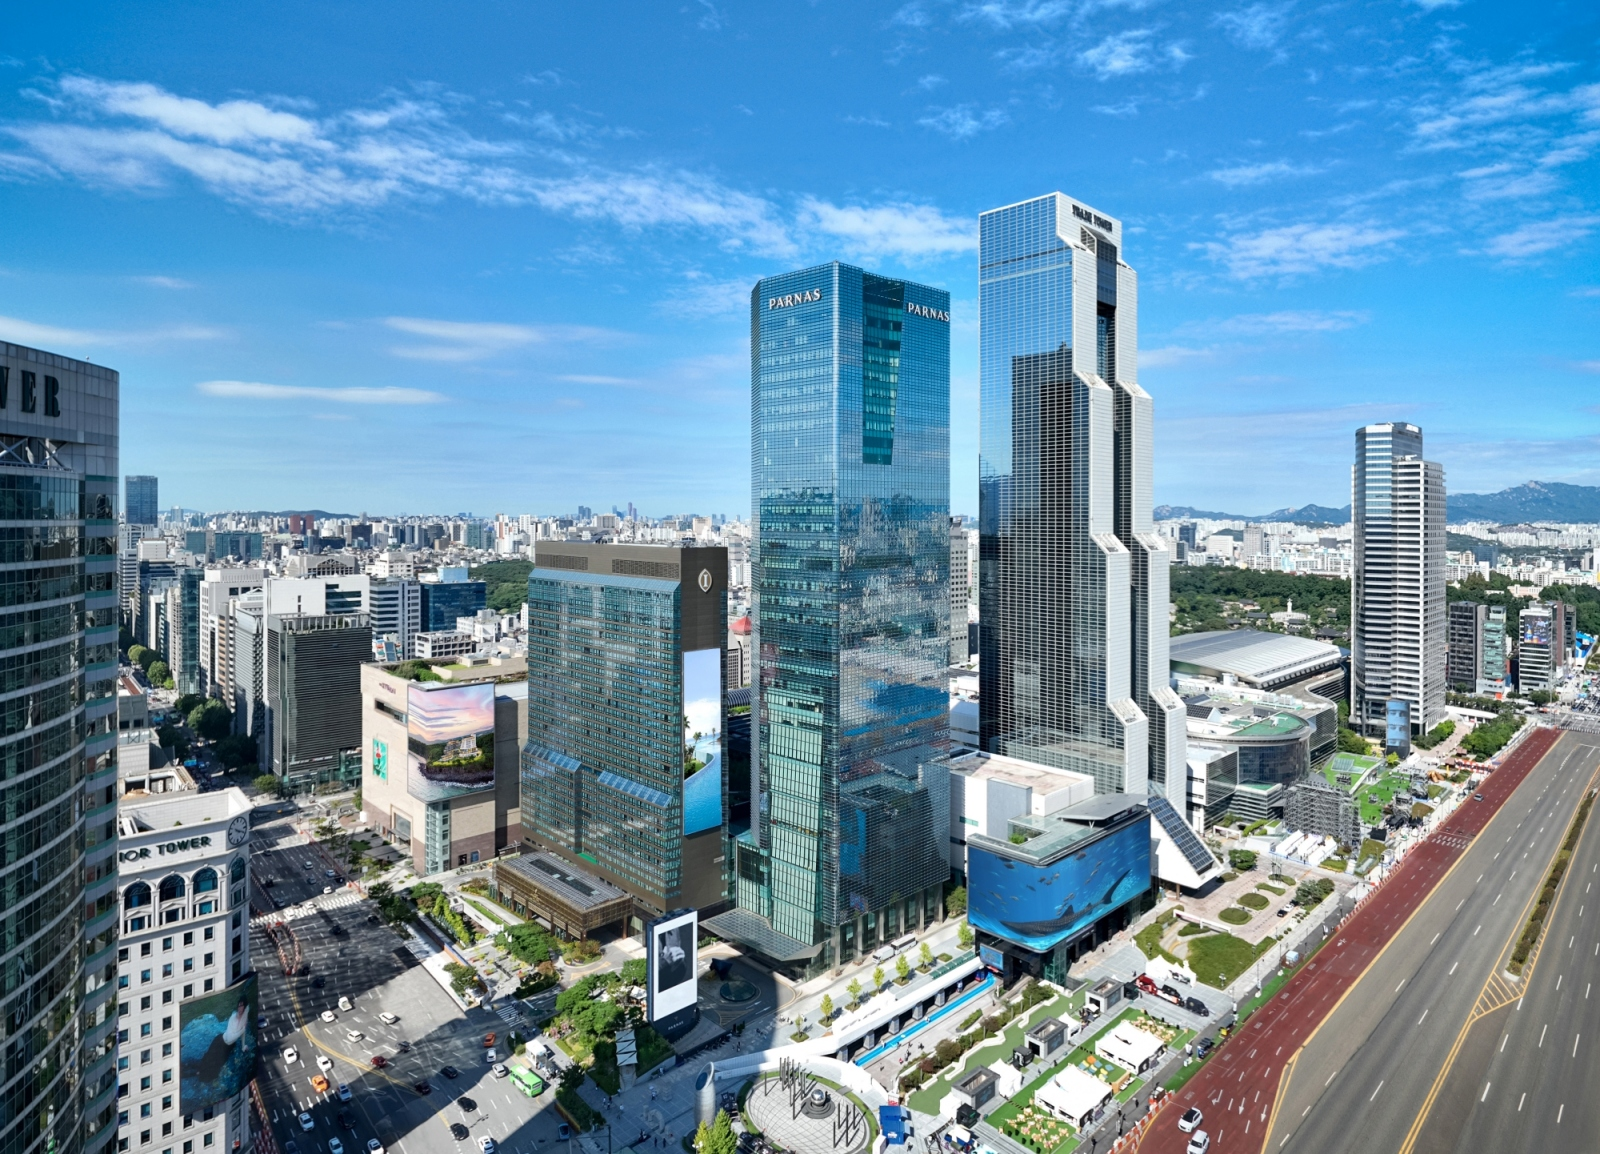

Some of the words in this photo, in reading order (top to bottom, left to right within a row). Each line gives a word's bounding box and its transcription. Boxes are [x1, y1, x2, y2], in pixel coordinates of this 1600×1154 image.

[769, 288, 821, 310] PARNAS
[908, 302, 950, 322] PARNAS
[156, 836, 211, 855] TOWER
